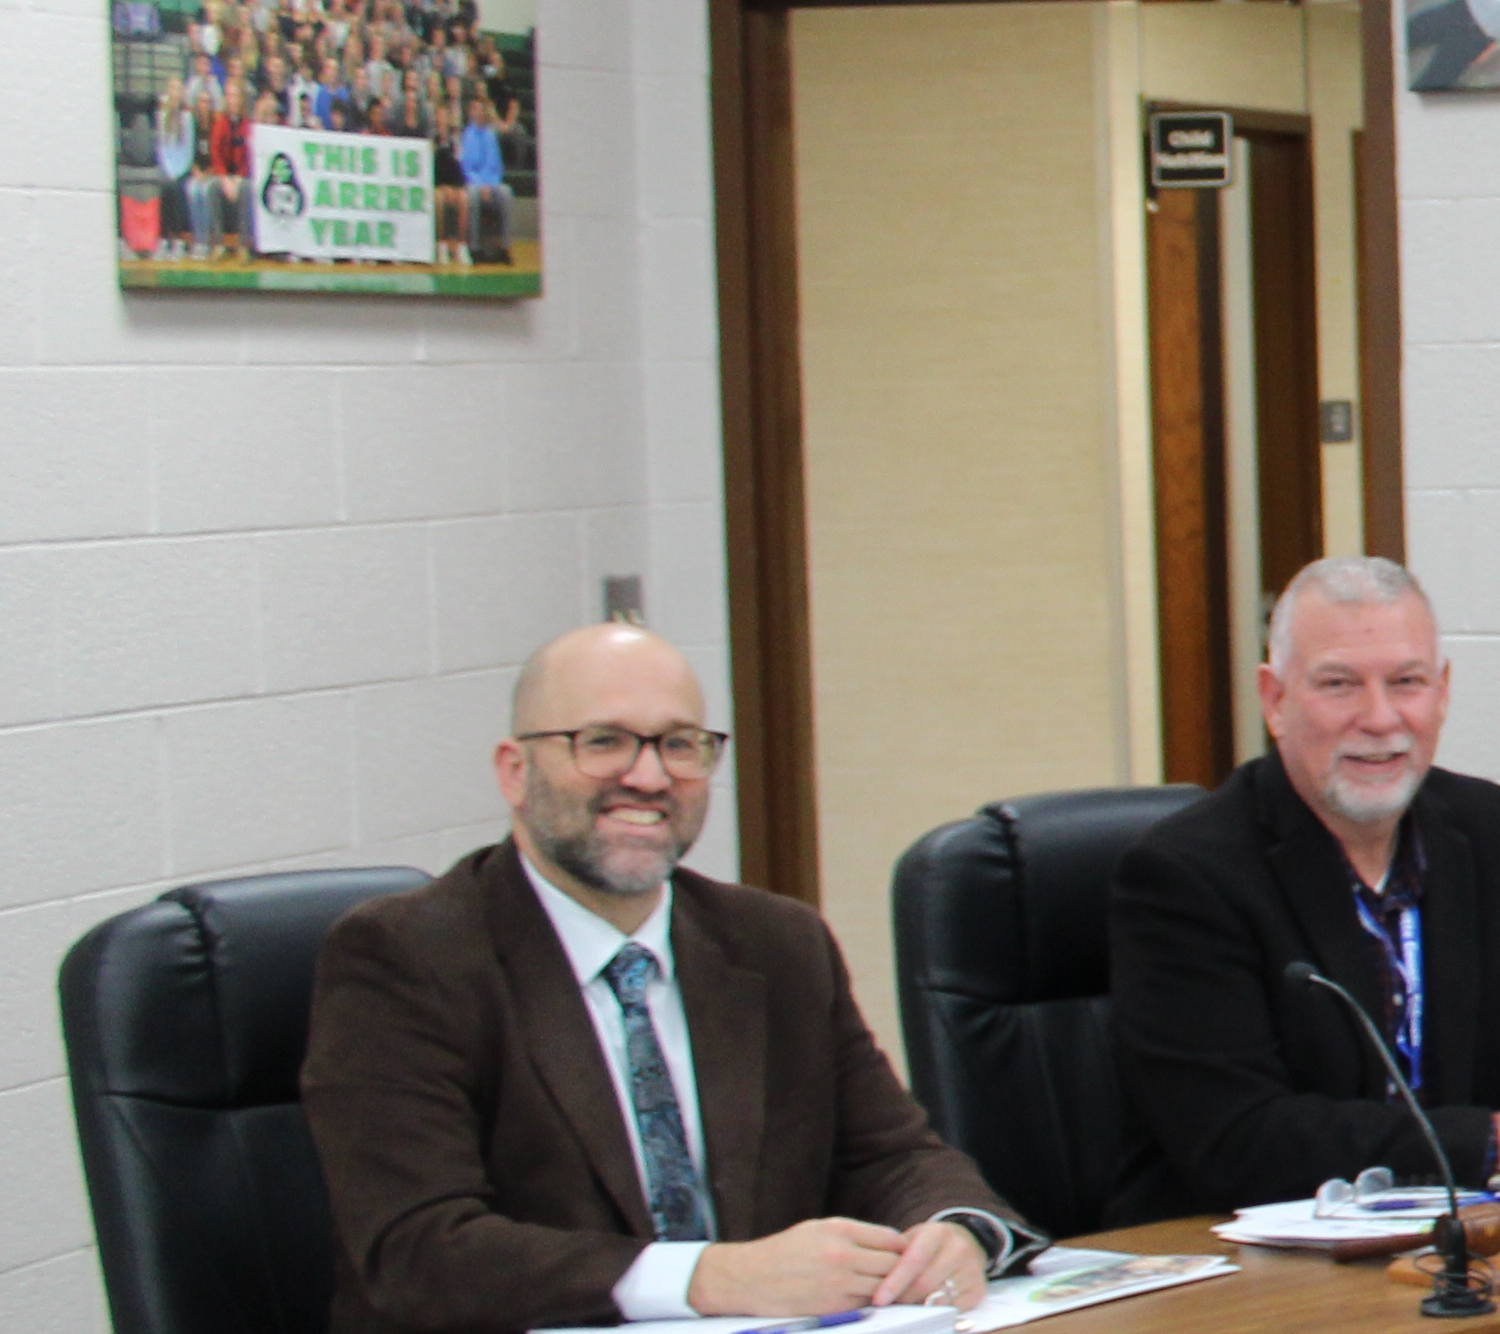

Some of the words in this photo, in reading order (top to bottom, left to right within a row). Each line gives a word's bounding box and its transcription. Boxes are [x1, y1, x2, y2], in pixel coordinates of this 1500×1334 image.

[304, 141, 376, 174] THIS
[391, 148, 419, 177] IS
[310, 219, 394, 247] YEAR
